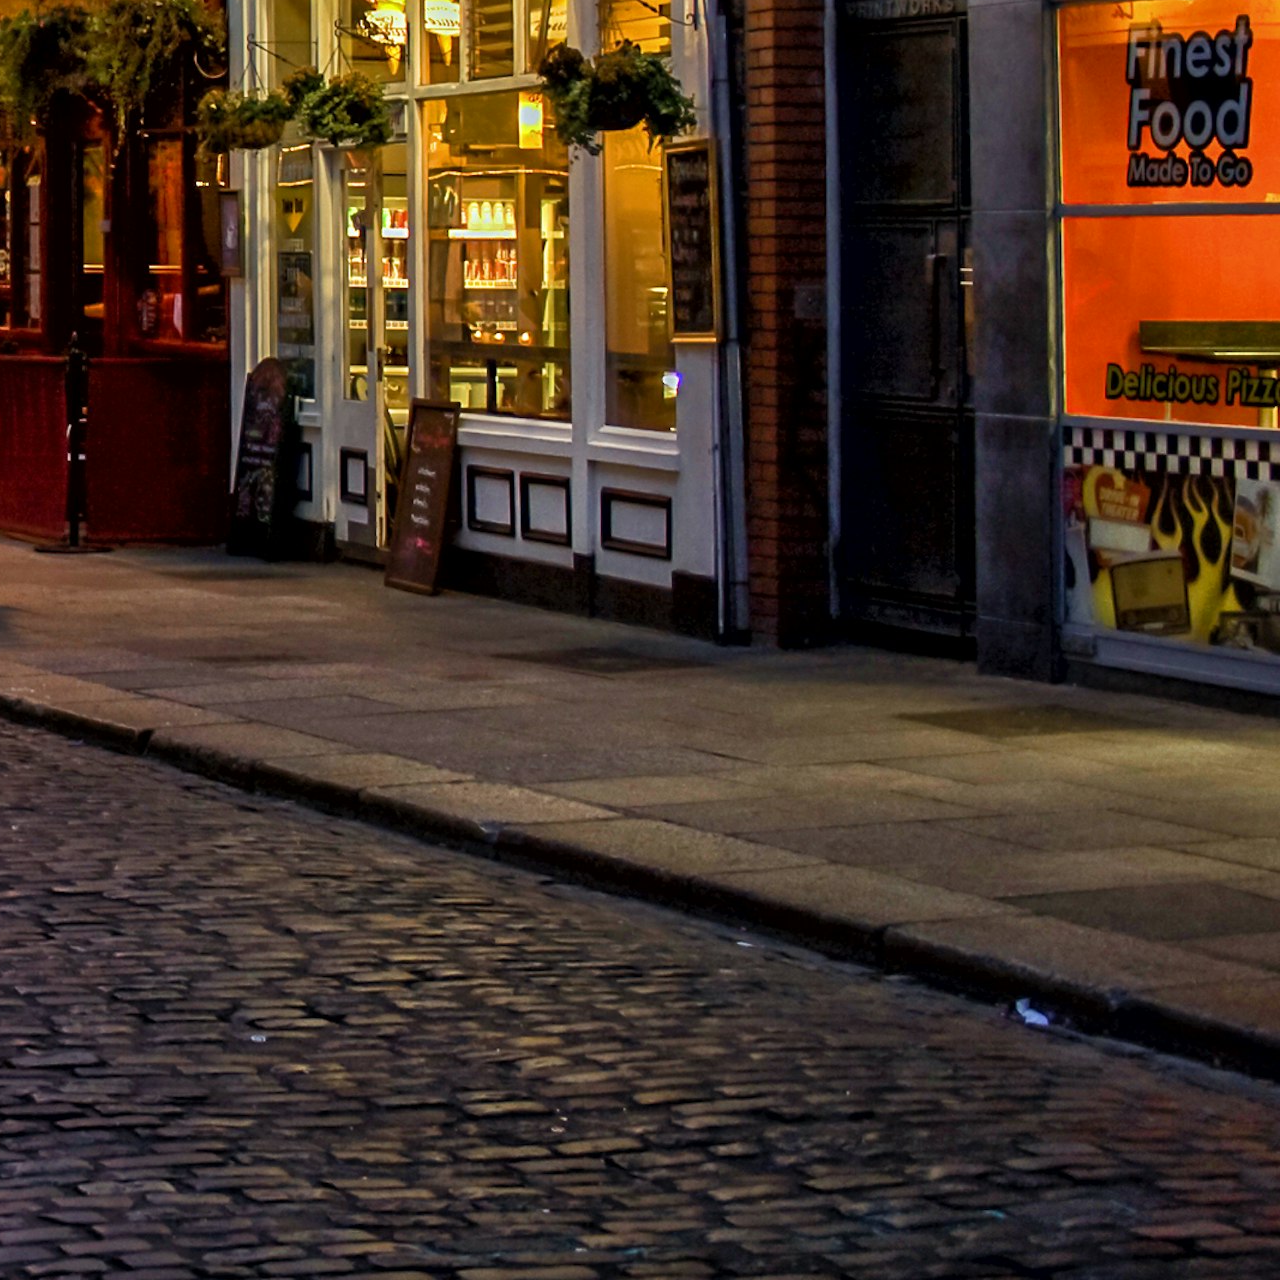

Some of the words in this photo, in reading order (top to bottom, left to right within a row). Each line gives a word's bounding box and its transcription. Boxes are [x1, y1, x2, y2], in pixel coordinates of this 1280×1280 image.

[1127, 23, 1250, 80] Finest
[1128, 81, 1249, 148] Food
[1128, 156, 1185, 183] Made
[1190, 156, 1212, 182] To
[1219, 155, 1248, 183] Go
[1106, 363, 1218, 403] Delicious
